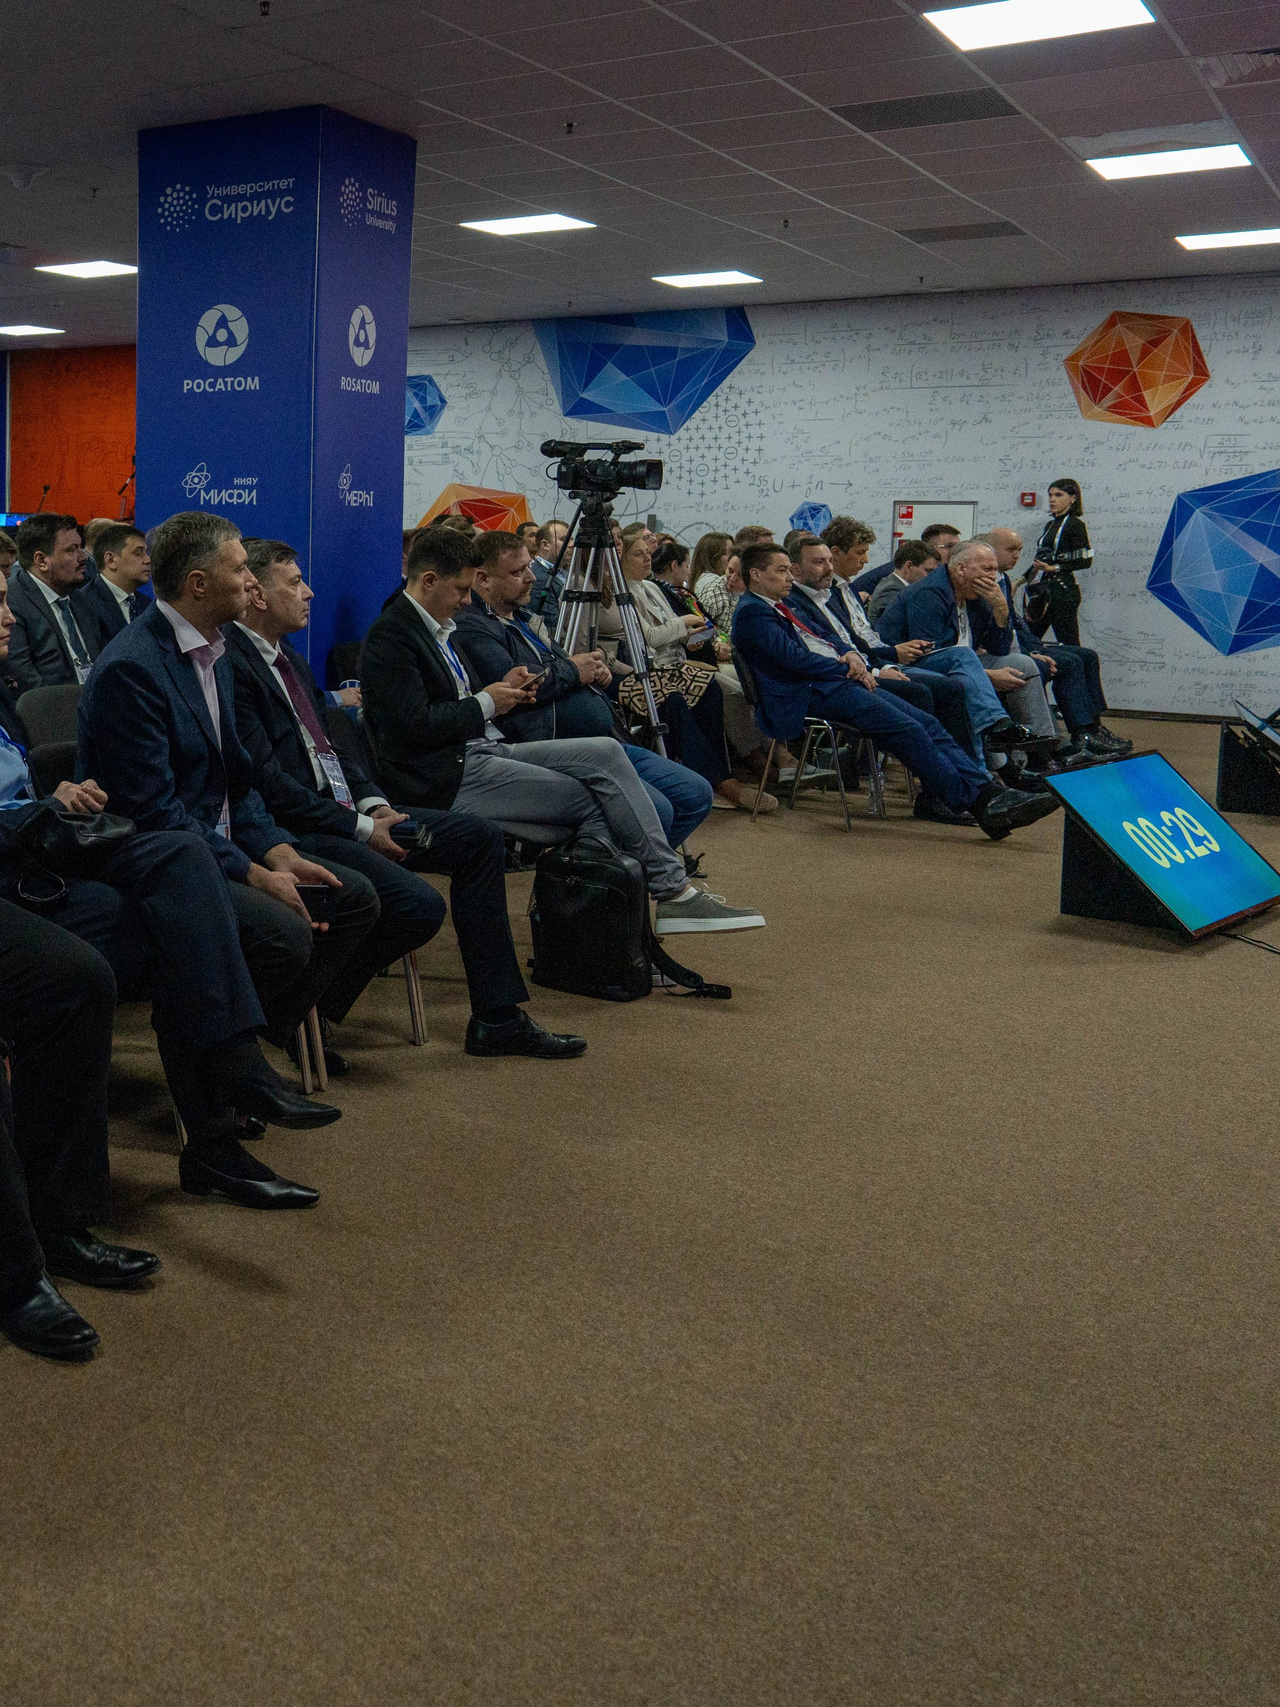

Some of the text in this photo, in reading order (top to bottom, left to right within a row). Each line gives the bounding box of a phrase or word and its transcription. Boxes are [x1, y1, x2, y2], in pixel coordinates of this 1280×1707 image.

[206, 177, 296, 198] Университет
[204, 196, 295, 224] Сириус
[366, 188, 398, 217] Sirius
[365, 212, 397, 234] University
[183, 376, 260, 393] РОСАТОМ
[340, 376, 380, 394] ROSATOM
[234, 477, 258, 486] НИЯУ
[200, 489, 257, 505] МИФИ
[345, 490, 374, 506] MEPhI
[1122, 807, 1221, 869] 00:29
